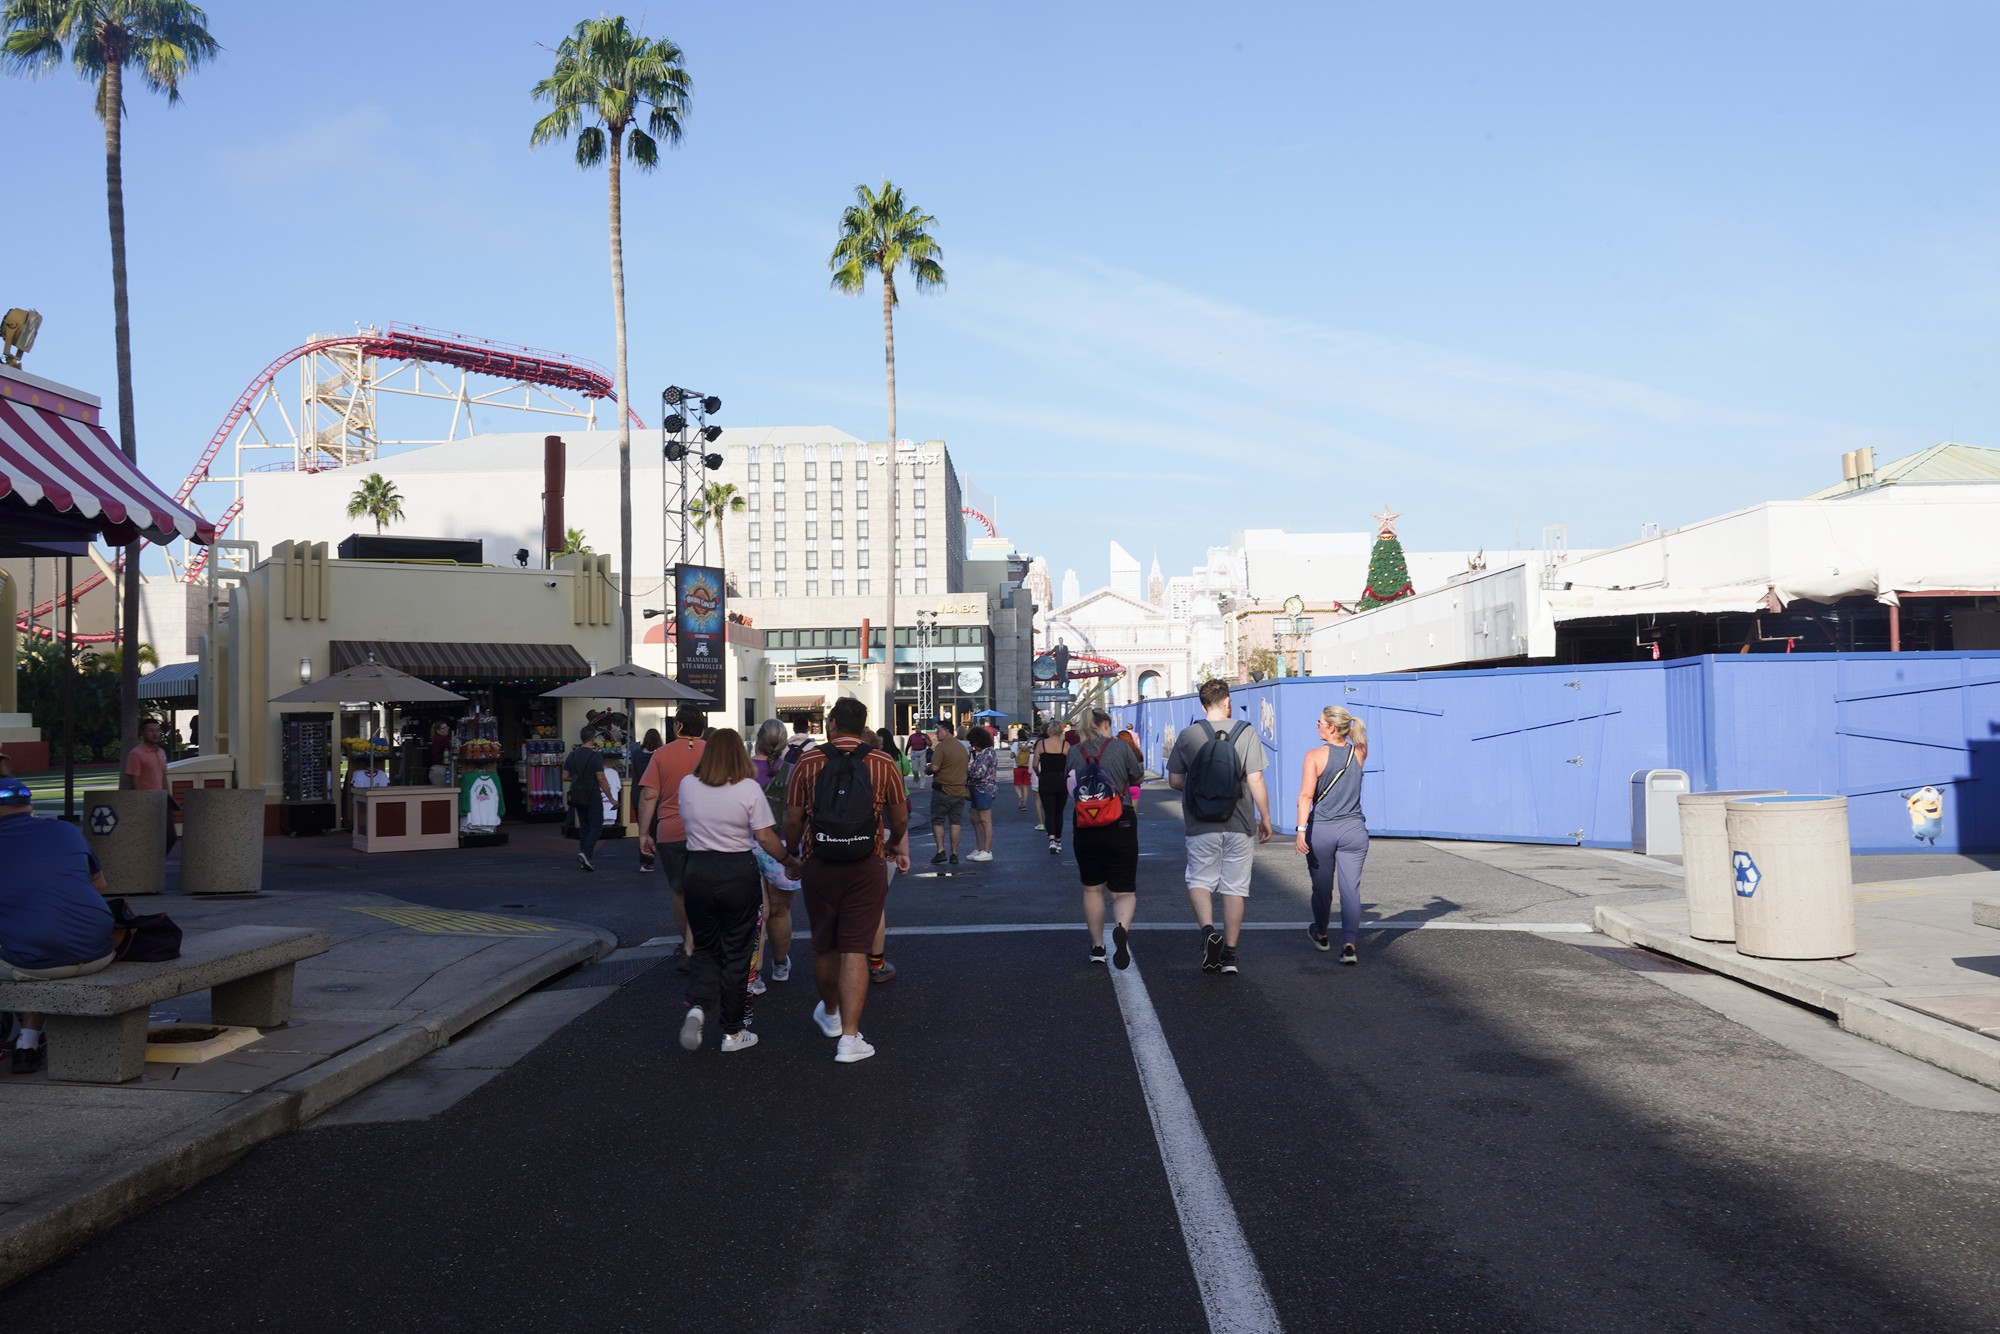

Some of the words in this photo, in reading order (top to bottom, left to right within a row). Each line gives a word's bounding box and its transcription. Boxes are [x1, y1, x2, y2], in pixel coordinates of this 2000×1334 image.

[873, 453, 941, 466] CMCAST
[953, 604, 979, 613] NBC
[681, 662, 723, 670] STEAMROLLER
[816, 832, 871, 845] Champion
